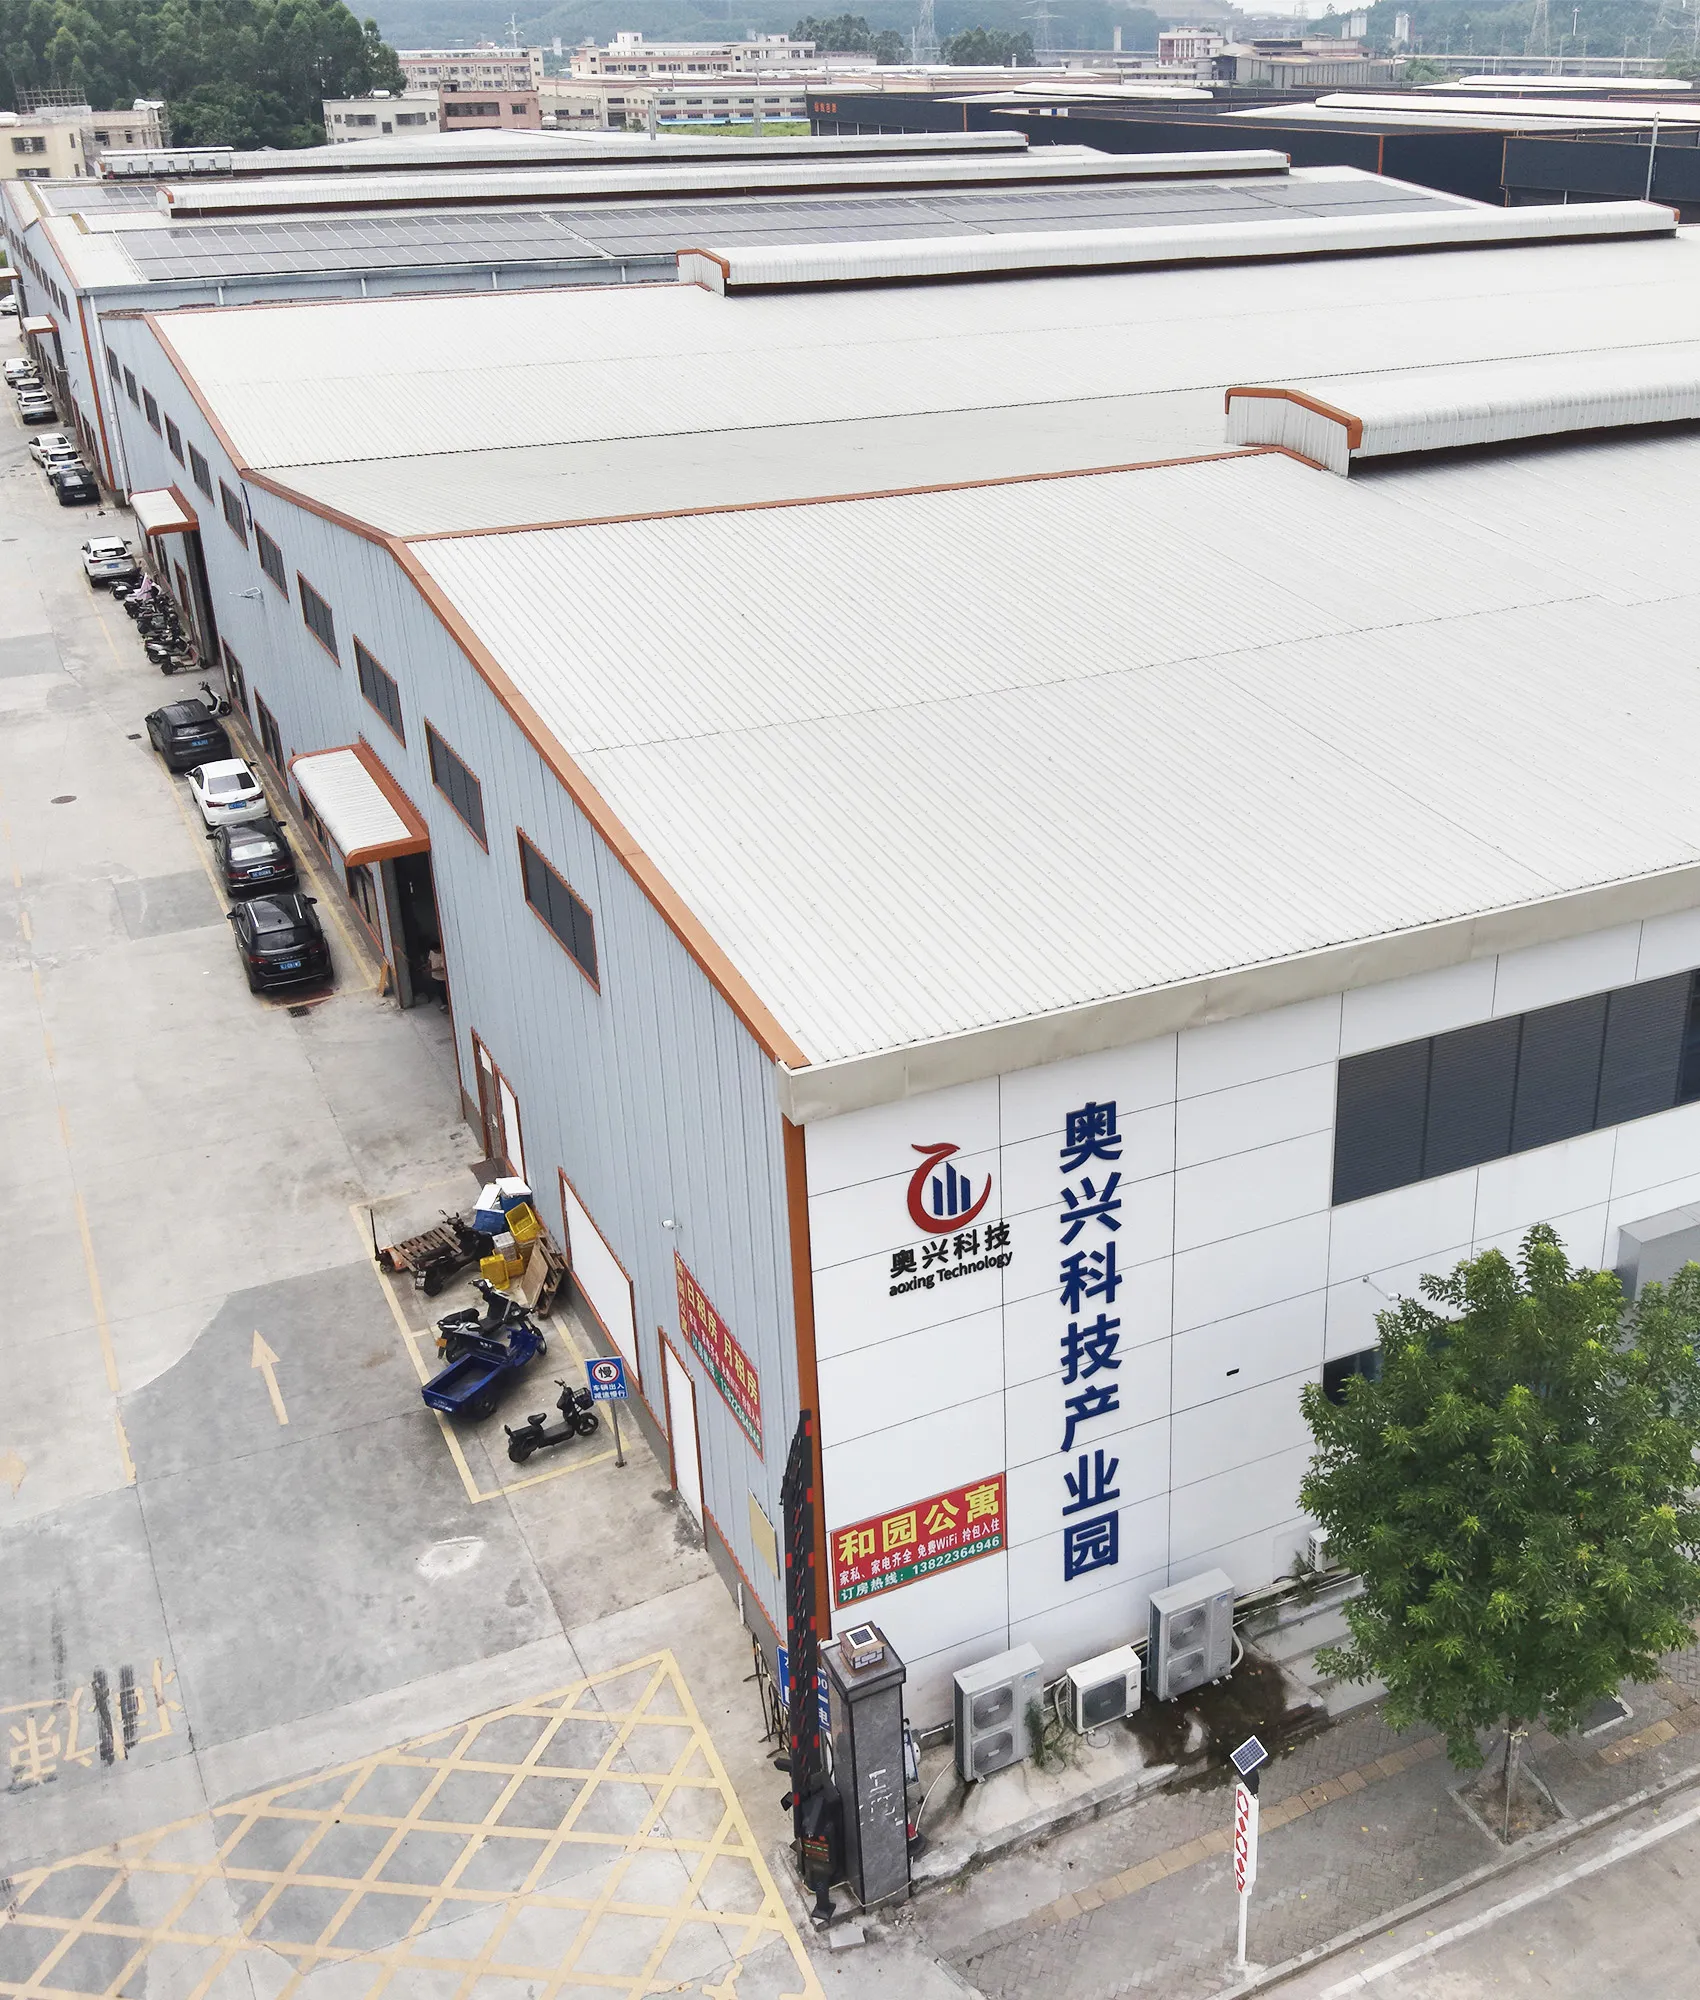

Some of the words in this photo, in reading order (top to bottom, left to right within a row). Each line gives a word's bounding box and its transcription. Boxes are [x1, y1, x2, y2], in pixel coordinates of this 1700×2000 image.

[890, 1221, 1011, 1279] 奥兴科技
[889, 1274, 935, 1297] aoxing
[936, 1251, 1013, 1282] Technology
[1060, 1100, 1123, 1583] 奥兴科技产业园
[598, 1366, 613, 1379] 慢
[838, 1482, 1000, 1566] 和园公寓
[917, 1532, 958, 1559] 免费WiFi
[962, 1517, 1001, 1544] 拎包入住
[912, 1535, 1000, 1576] 13822364946
